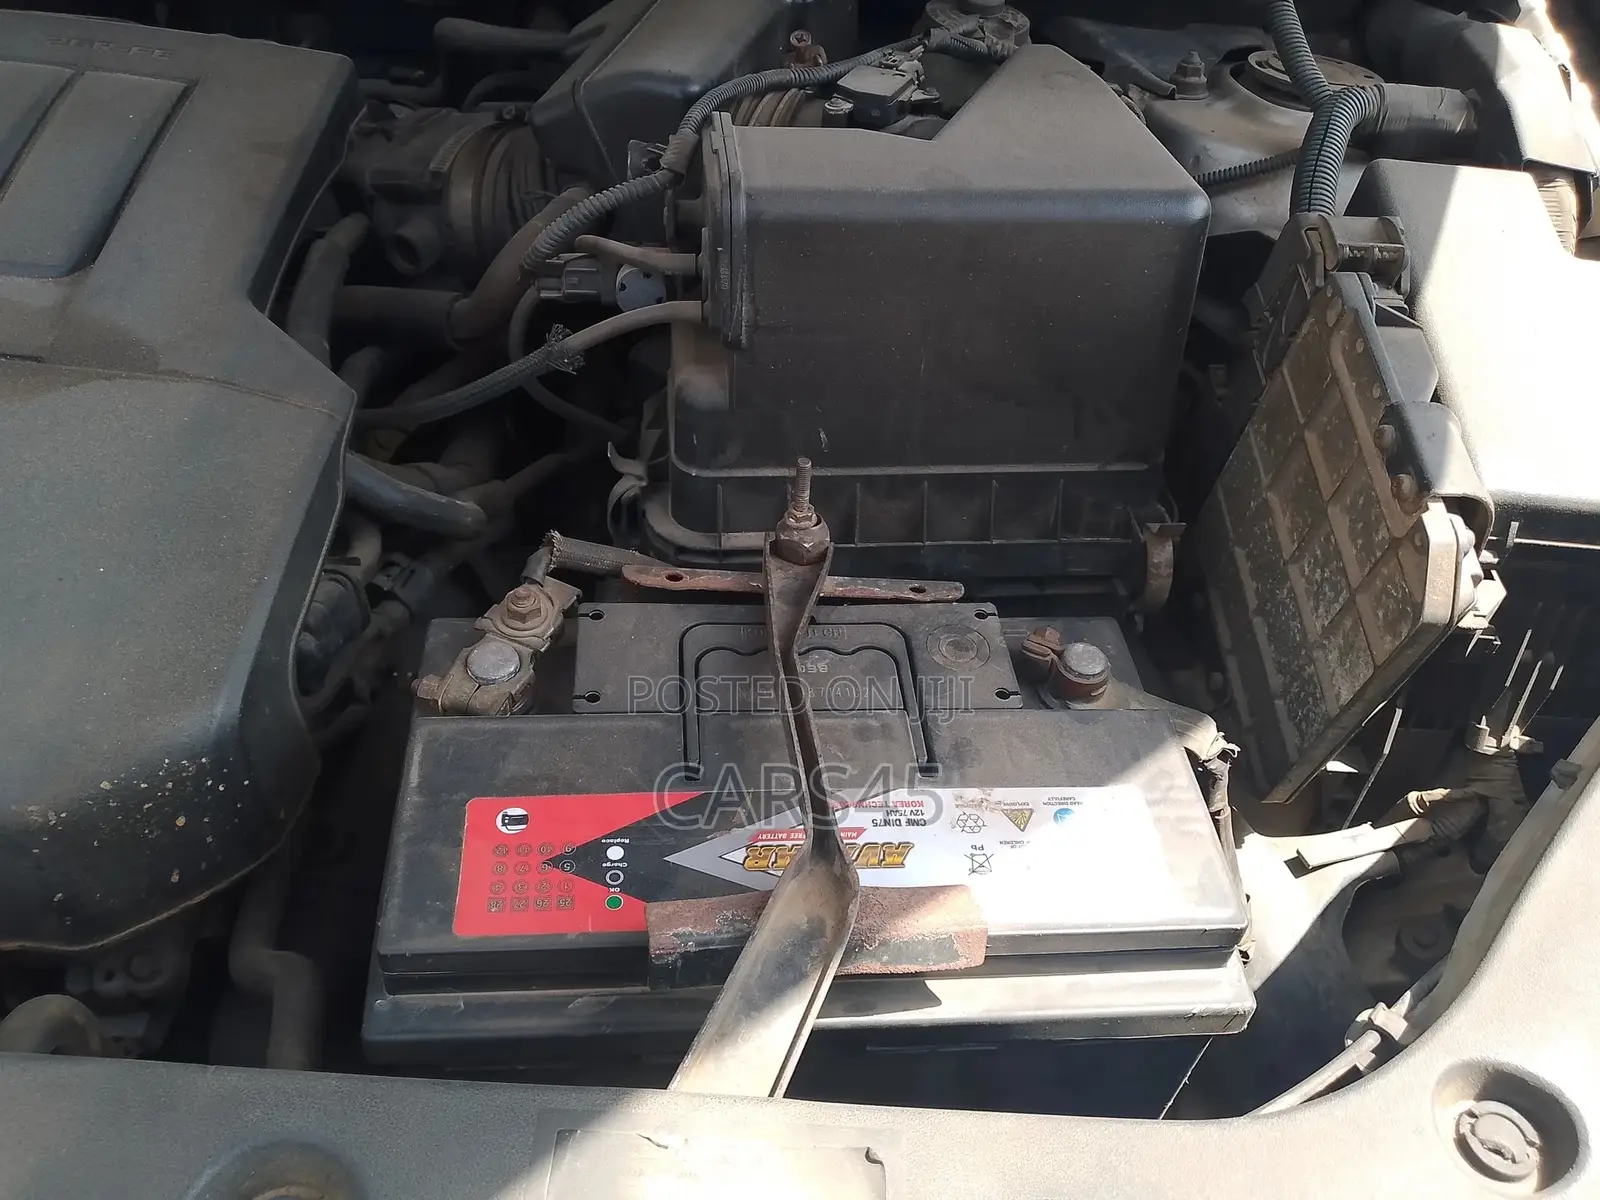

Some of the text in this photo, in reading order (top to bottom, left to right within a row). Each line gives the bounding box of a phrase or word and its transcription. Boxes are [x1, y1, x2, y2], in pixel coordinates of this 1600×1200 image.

[891, 800, 924, 808] KOREA
[871, 818, 927, 827] CMF DIN75
[758, 832, 787, 840] BATTERY
